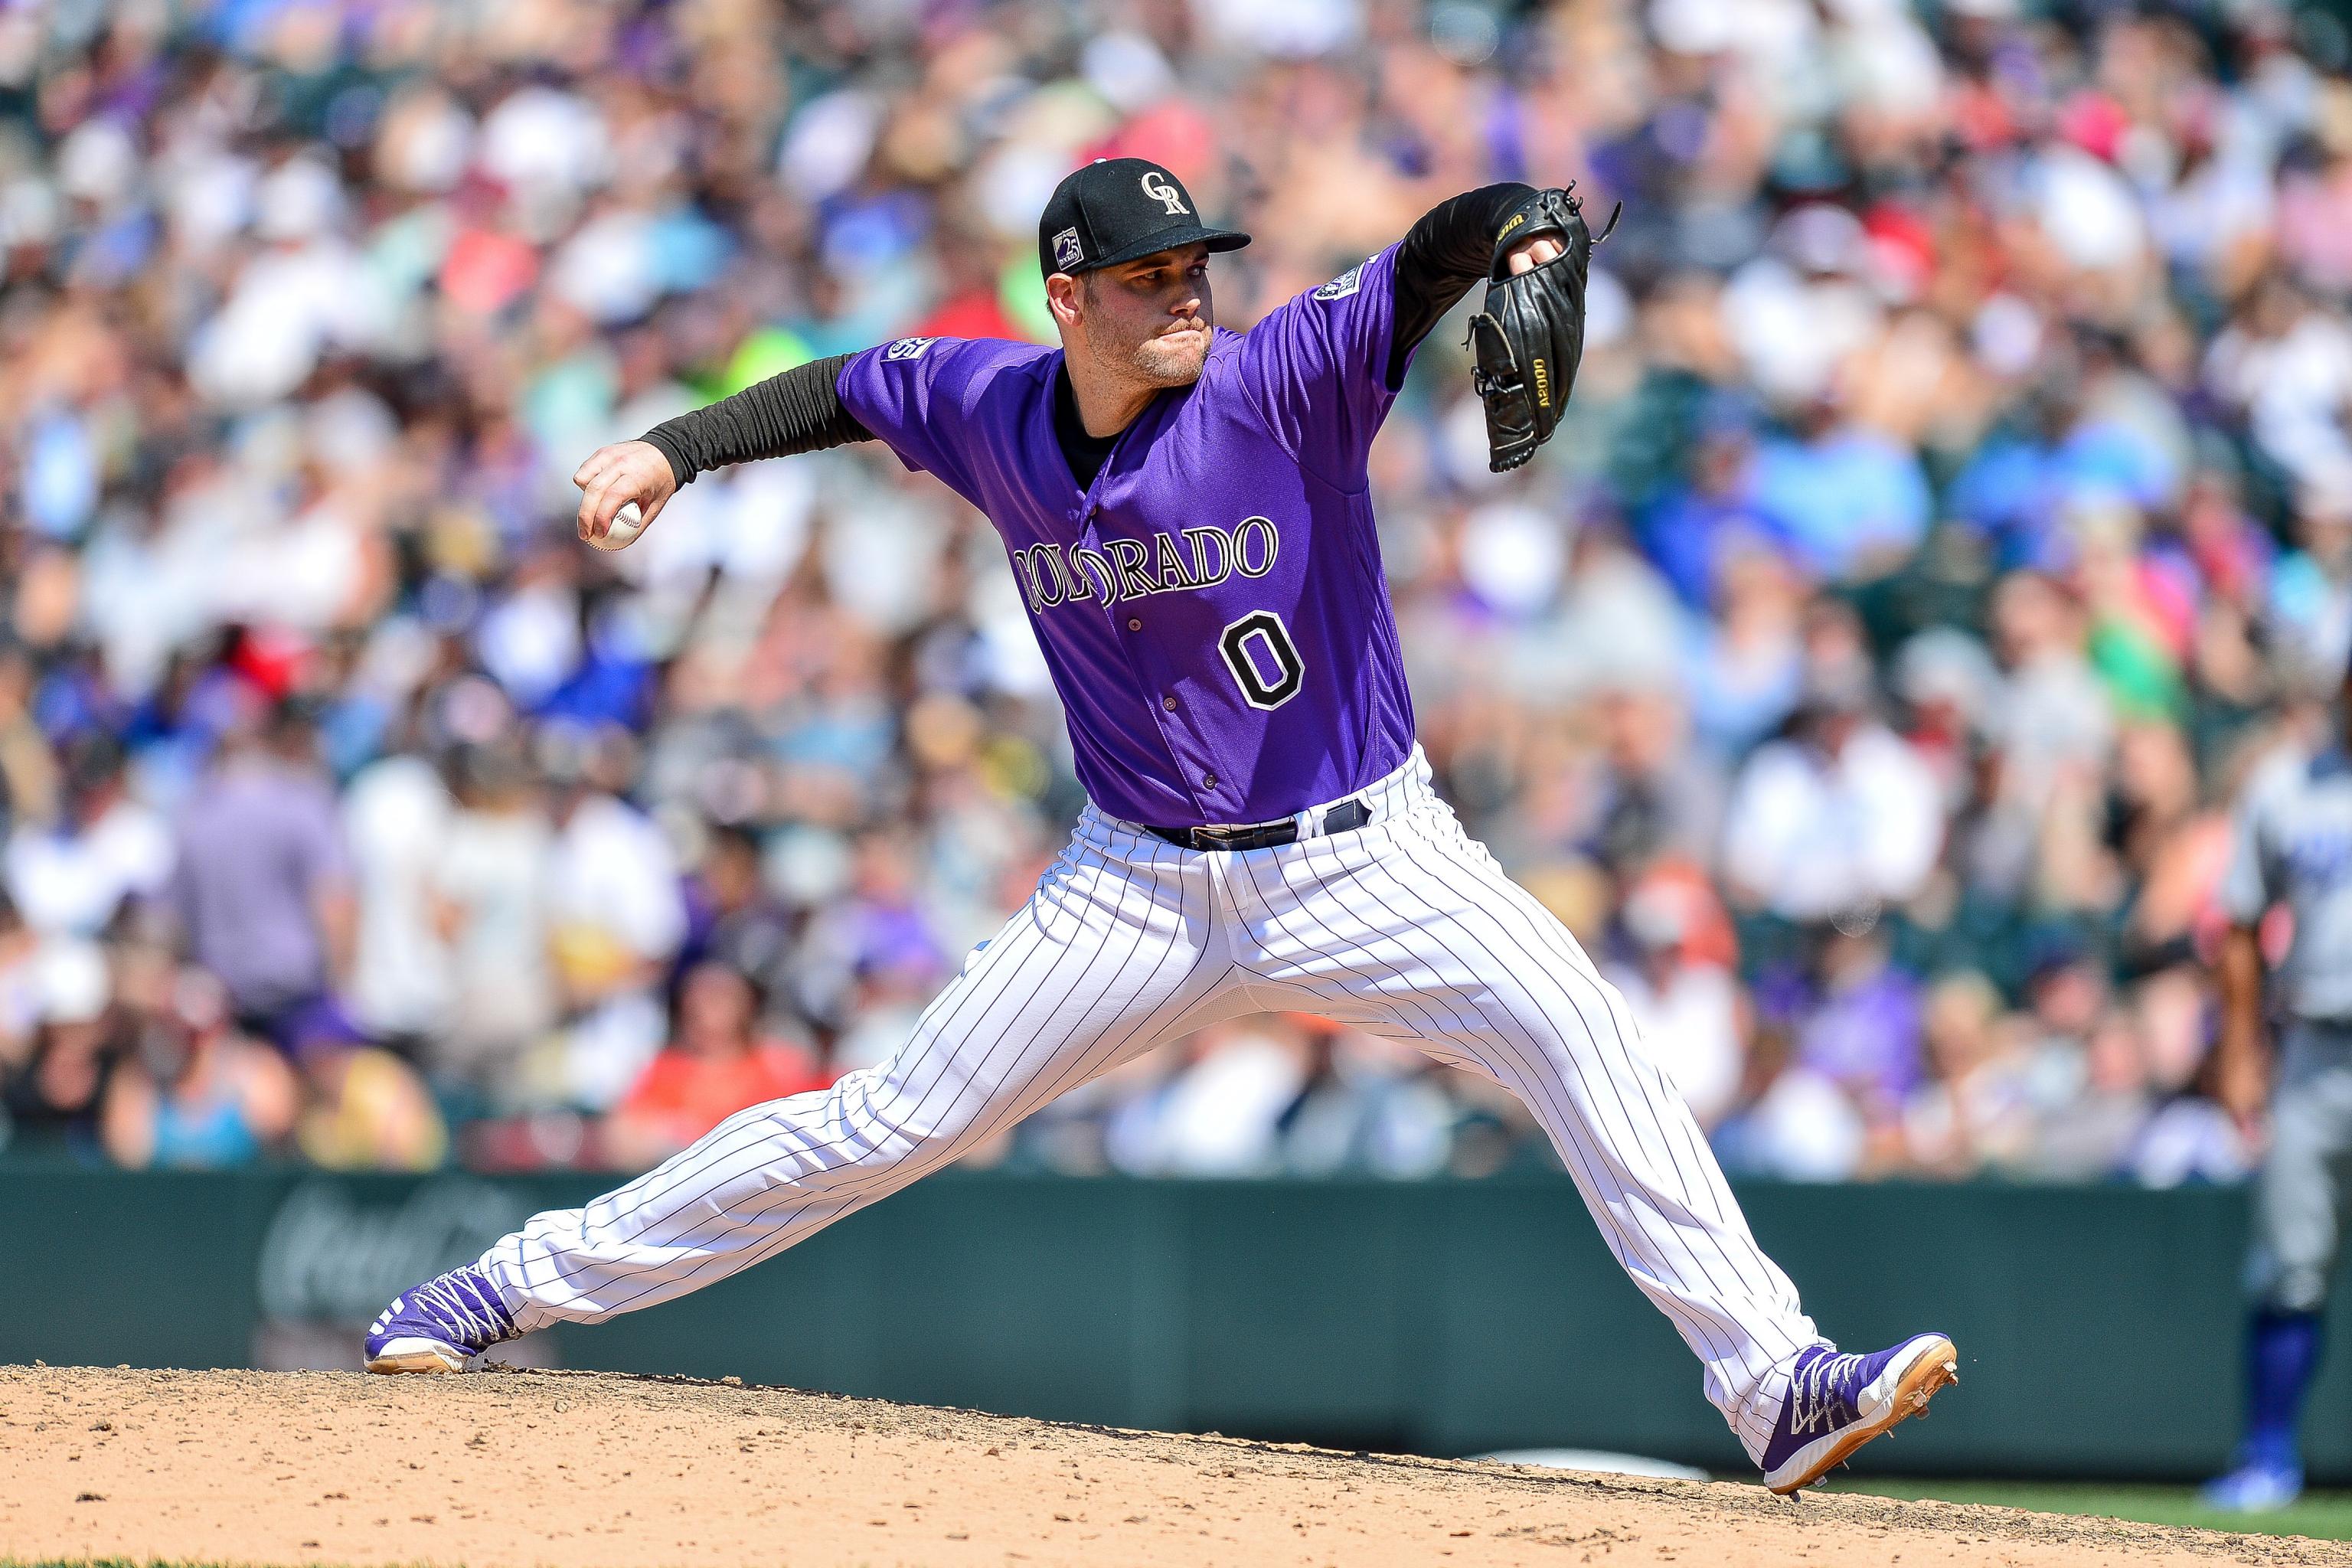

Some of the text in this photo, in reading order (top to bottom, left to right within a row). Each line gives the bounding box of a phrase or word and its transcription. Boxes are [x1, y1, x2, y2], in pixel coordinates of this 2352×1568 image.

[1142, 172, 1191, 214] CR
[1063, 237, 1080, 261] 25
[1533, 358, 1550, 408] A2000
[1014, 515, 1279, 615] COLORADO
[1217, 609, 1306, 711] 0
